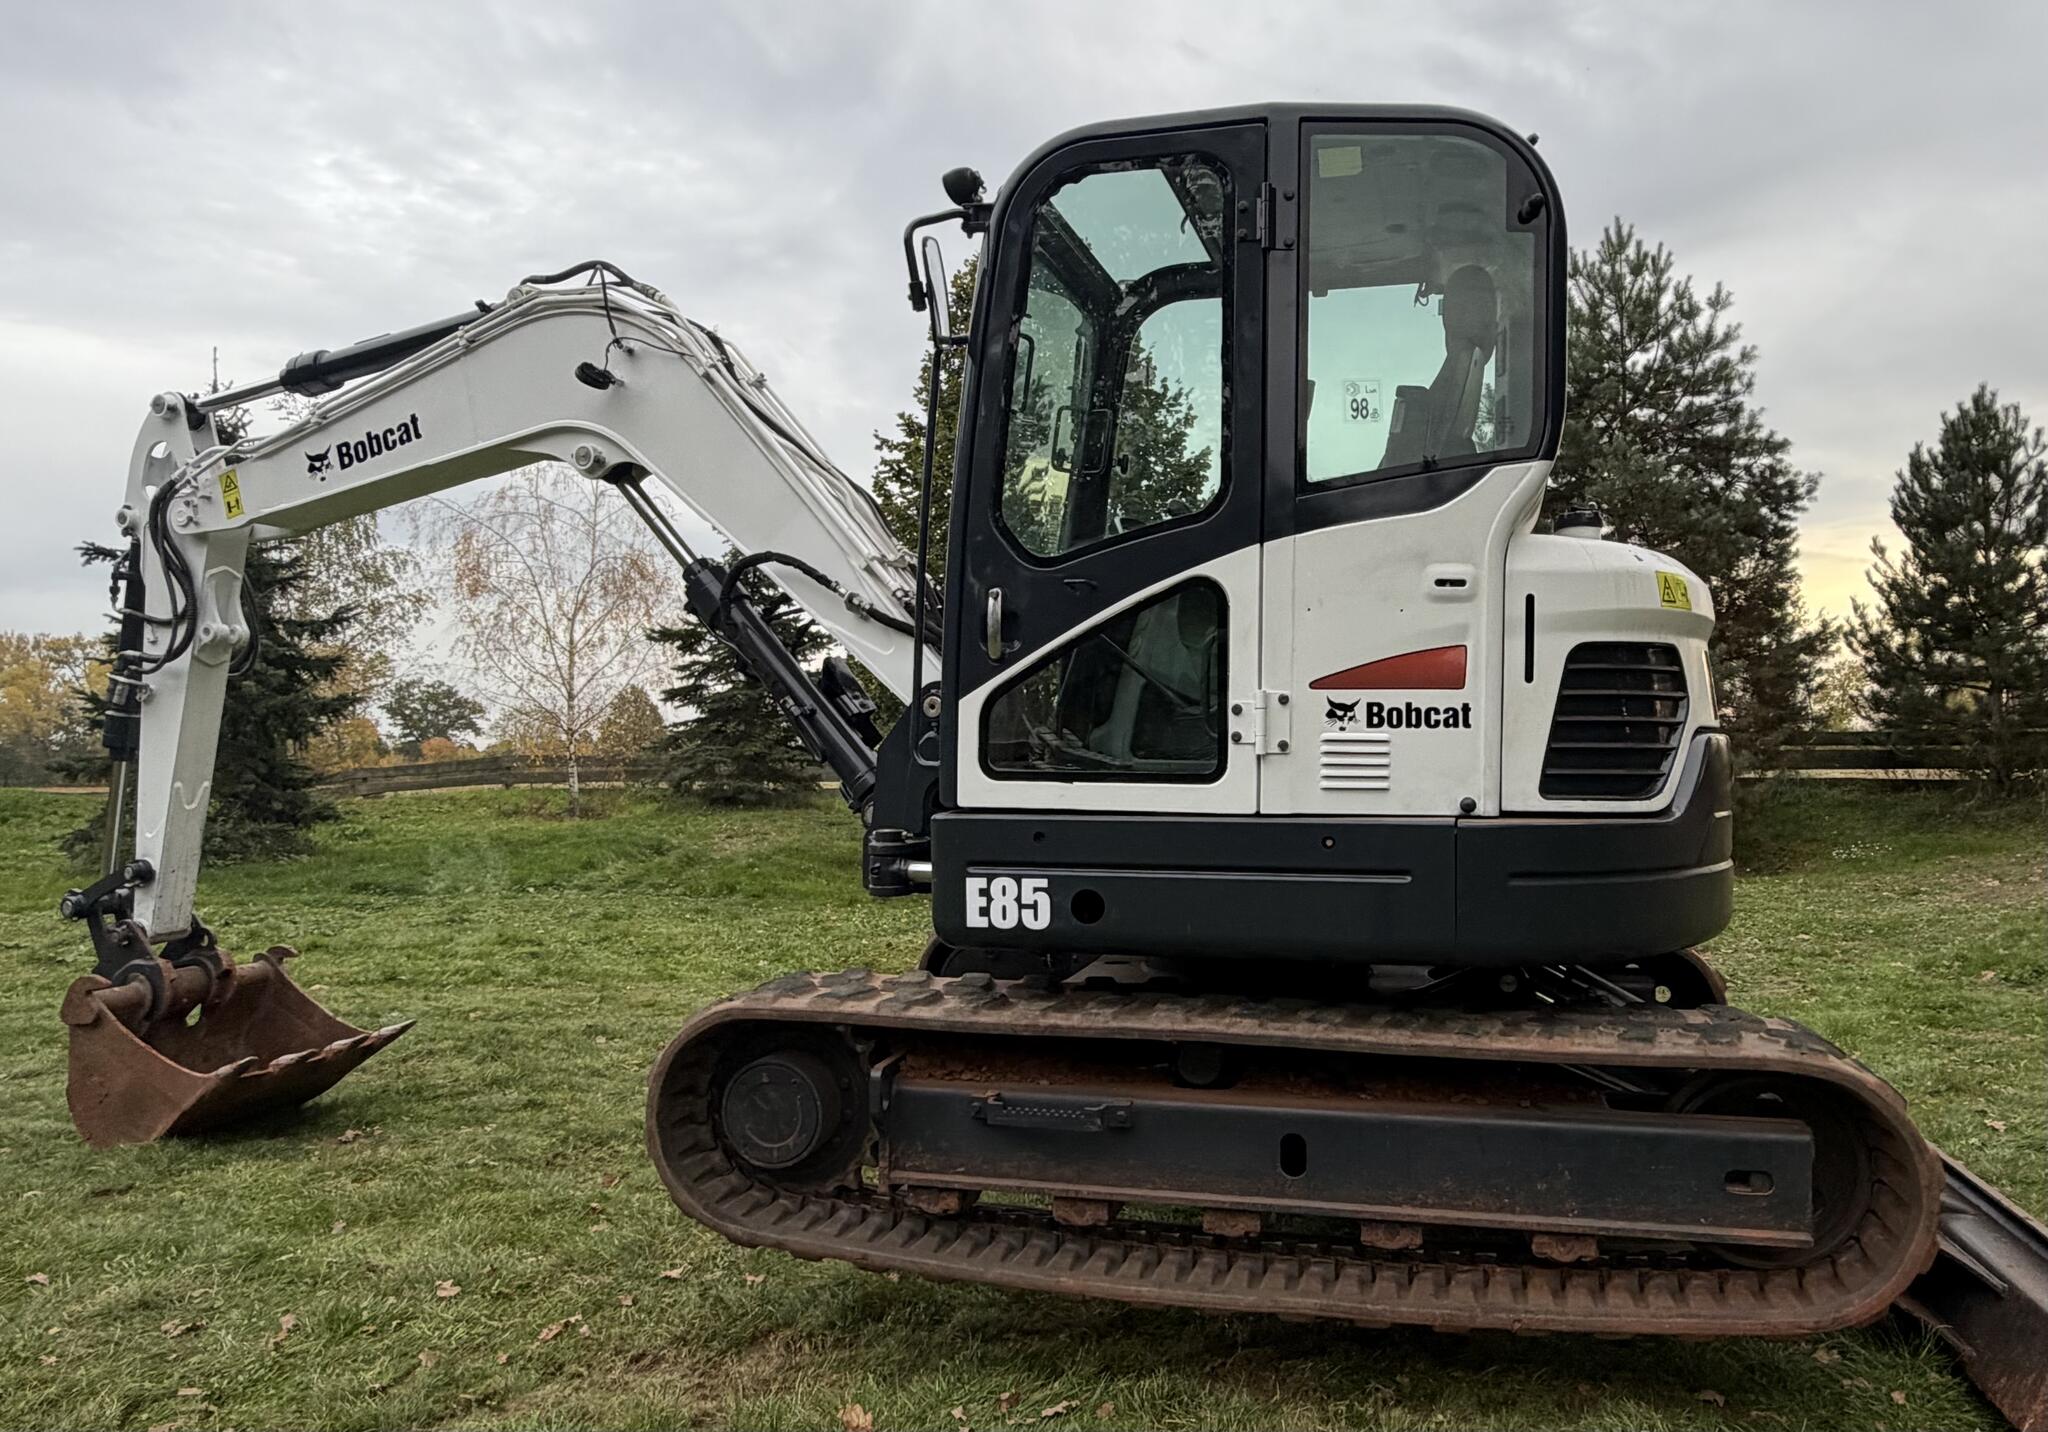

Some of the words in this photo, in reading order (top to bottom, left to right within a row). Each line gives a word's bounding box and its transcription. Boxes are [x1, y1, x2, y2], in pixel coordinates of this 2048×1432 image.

[1350, 398, 1369, 420] 98
[336, 413, 422, 471] Bobcat
[1366, 701, 1472, 729] Bobcat
[965, 876, 1051, 930] E85
